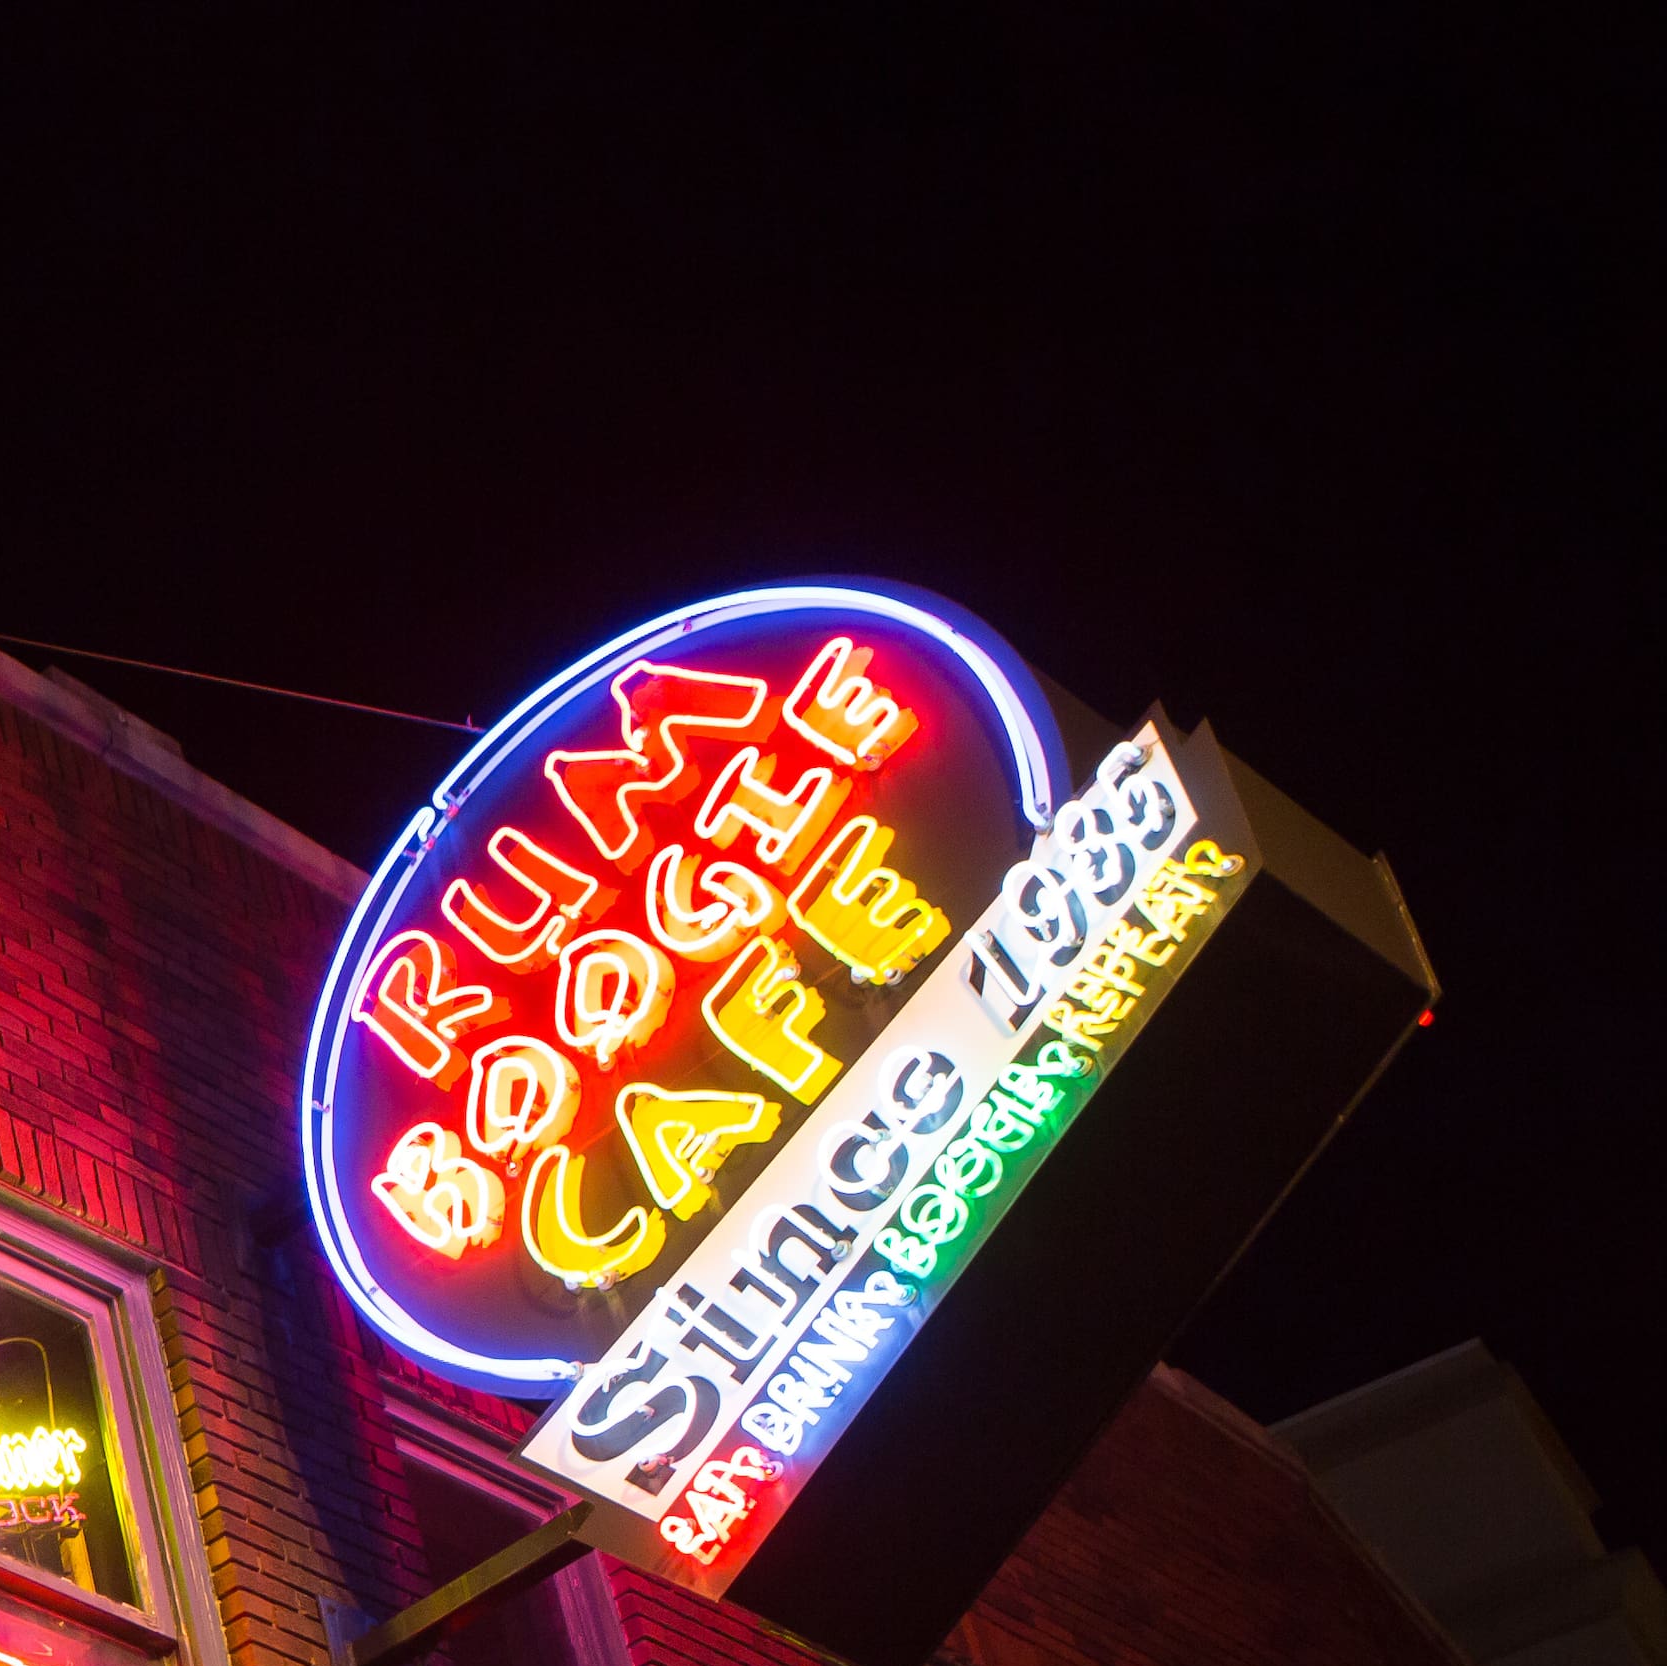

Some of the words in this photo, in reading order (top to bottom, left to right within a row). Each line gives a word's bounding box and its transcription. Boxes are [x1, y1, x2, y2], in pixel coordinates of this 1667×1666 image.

[350, 658, 770, 1080] RUM
[369, 635, 921, 1260] BOOGIE
[521, 813, 954, 1290] CAFE
[563, 1044, 967, 1497] Since
[963, 738, 1179, 1035] 1985
